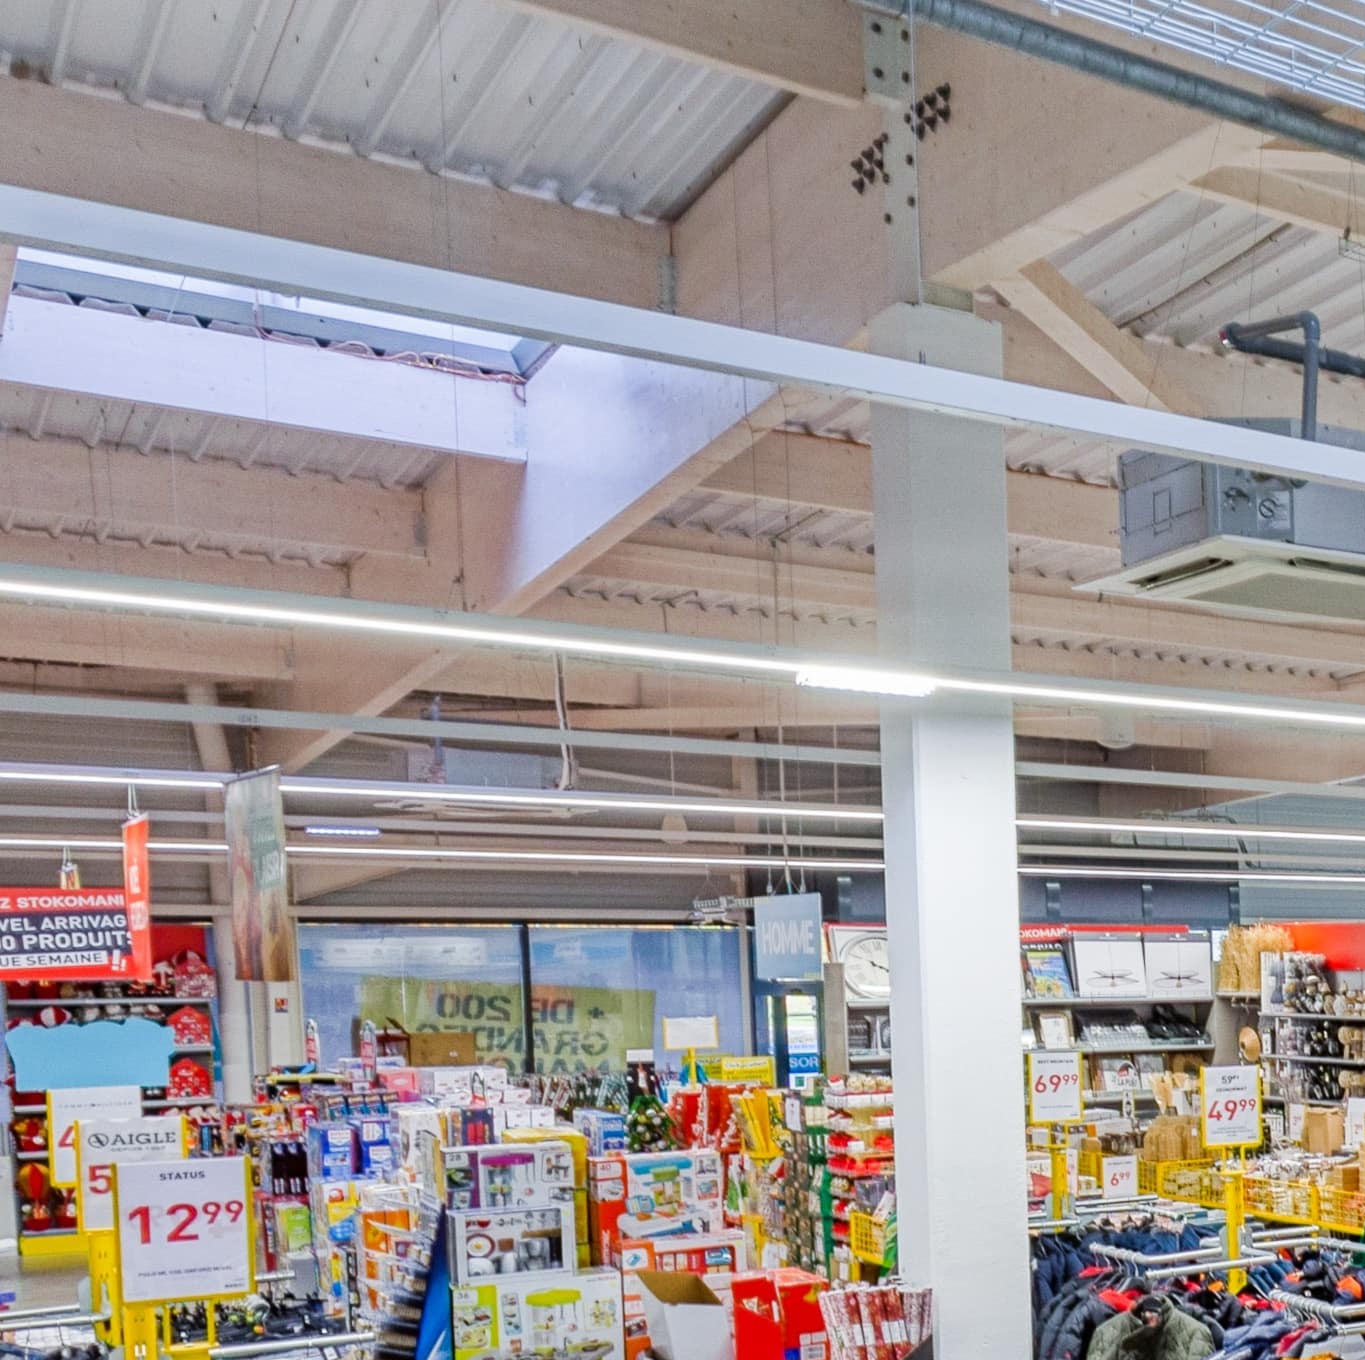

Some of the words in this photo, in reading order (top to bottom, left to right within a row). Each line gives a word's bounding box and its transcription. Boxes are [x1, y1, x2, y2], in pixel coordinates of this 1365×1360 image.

[17, 895, 124, 908] STOKOMANI
[41, 915, 127, 931] ARRIVAG
[761, 920, 815, 954] HOMME
[26, 953, 103, 965] SEMAINE
[1034, 1074, 1079, 1093] 6999
[1208, 1100, 1256, 1121] 4999
[113, 1132, 176, 1146] AIGLE
[159, 1171, 206, 1181] STATUS
[128, 1200, 244, 1245] 1299
